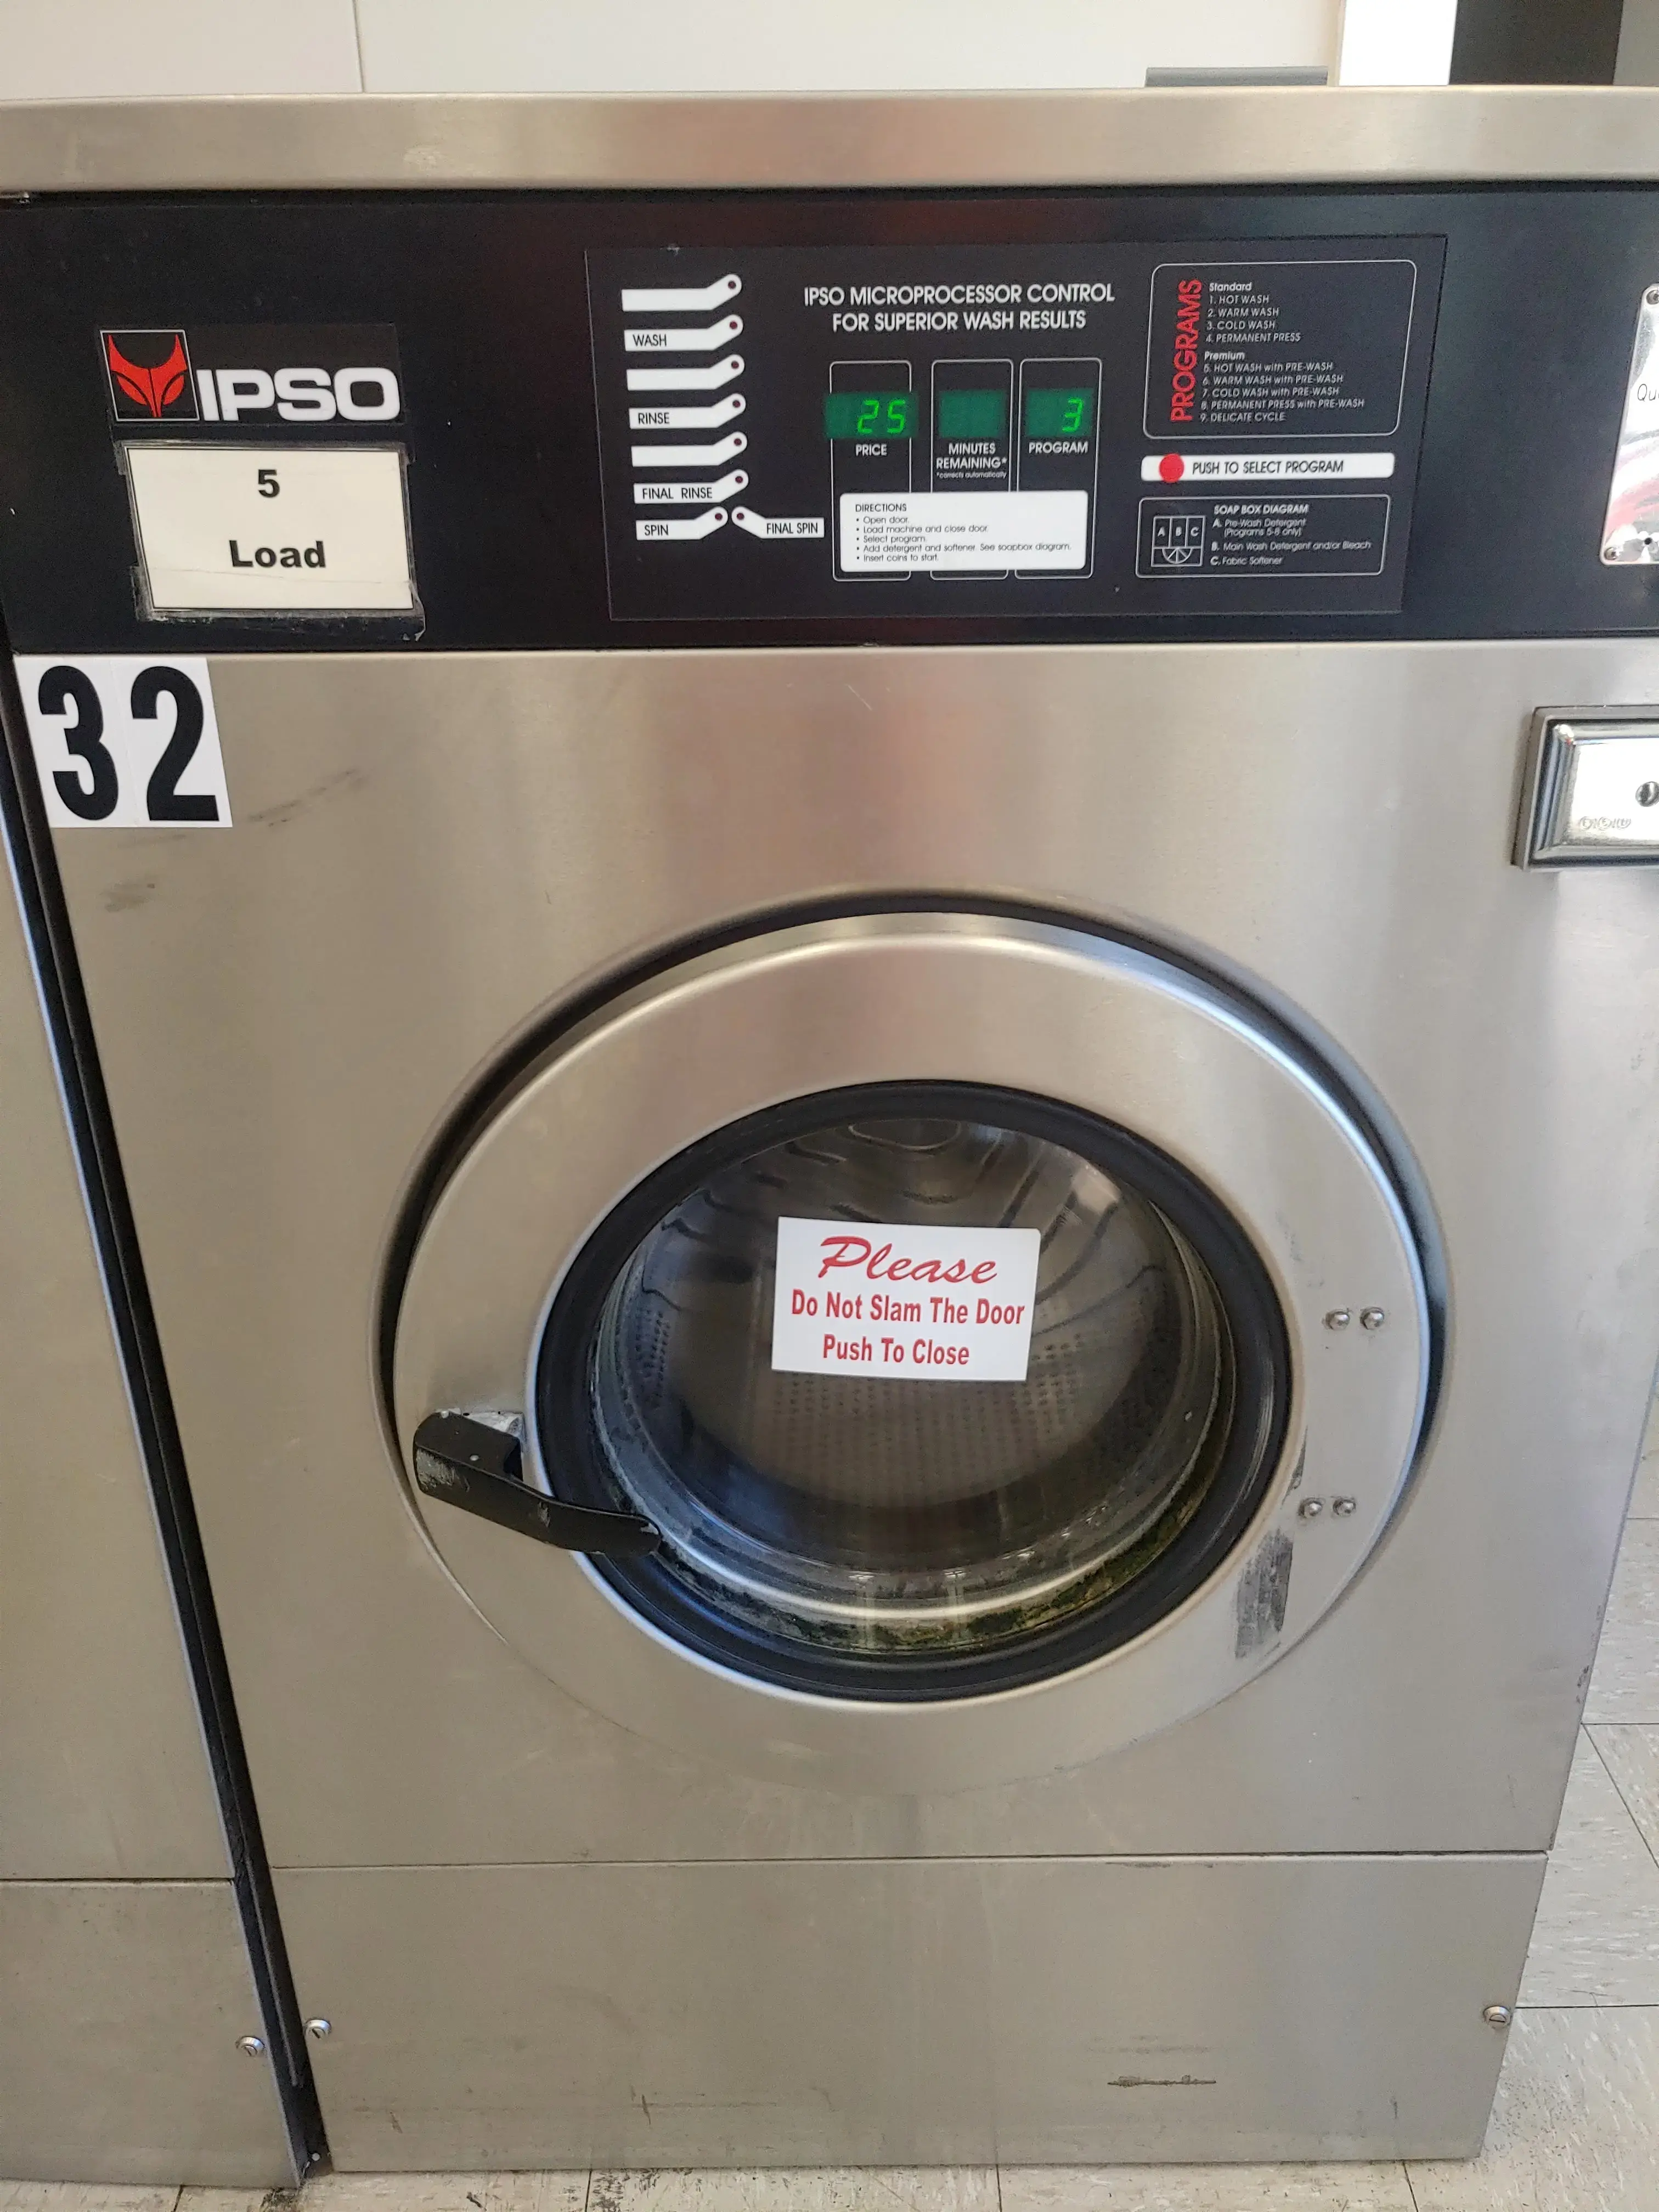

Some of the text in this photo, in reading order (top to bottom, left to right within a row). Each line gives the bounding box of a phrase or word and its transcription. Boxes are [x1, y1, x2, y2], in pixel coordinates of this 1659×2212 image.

[1209, 282, 1252, 291] Standard
[804, 284, 1115, 306] IPSO MICROPROCESSOR CONTROL
[1219, 295, 1240, 304] HOT
[1242, 295, 1269, 303] WASH
[1218, 308, 1249, 317] WARM
[1251, 307, 1279, 317] WASH
[833, 310, 1086, 331] FOR SUPERIOR WASH RESULTS
[1217, 320, 1245, 330] COLD
[1248, 320, 1276, 329] WASH
[633, 334, 667, 347] WASH
[1216, 333, 1271, 342] PERMANENT
[1273, 332, 1301, 342] PRESS
[1171, 279, 1202, 421] PROGRAMS
[1204, 351, 1245, 360] Premium
[1214, 363, 1233, 373] HOT
[1235, 363, 1261, 372] WASH
[1265, 363, 1283, 372] with
[1285, 362, 1333, 371] PRE-WASH
[1214, 376, 1243, 385] WARM
[1245, 376, 1271, 385] WASH
[1274, 375, 1293, 384] with
[1296, 374, 1343, 383] PRE-WASH
[196, 367, 400, 421] IPSO
[1212, 388, 1240, 398] COLD
[1242, 388, 1268, 397] WASH
[1271, 388, 1289, 397] with
[1293, 387, 1339, 396] PRE-WASH
[1211, 400, 1266, 410] PERMANENT
[1268, 399, 1295, 409] PRESS
[1297, 399, 1317, 408] with
[1318, 399, 1364, 408] PRE-WASH
[638, 413, 669, 425] RINSE
[857, 399, 906, 434] 25
[1062, 397, 1083, 432] 3
[1211, 412, 1252, 422] DELICATE
[1255, 411, 1287, 422] CYCLE
[856, 444, 887, 456] PRICE
[949, 442, 996, 454] MINUTES
[1029, 442, 1088, 454] PROGRAM
[1193, 460, 1344, 475] PUSH TO SELECT PROGRAM
[258, 469, 280, 498] 5
[642, 487, 712, 499] FINAL RINSE
[855, 504, 907, 512] DIRECTIONS
[1214, 504, 1309, 515] SOAP BOX DIAGRAM
[864, 516, 886, 525] Open
[1224, 518, 1262, 527] Pre-Wash
[1264, 518, 1307, 528] Detergent
[644, 524, 668, 536] SPIN
[766, 523, 817, 534] FINAL SPIN
[1158, 527, 1165, 537] A
[1176, 527, 1182, 537] B
[1190, 527, 1200, 537] C
[1224, 528, 1265, 538] (Programs
[1282, 527, 1302, 537] only)
[883, 544, 922, 554] detergent
[980, 543, 995, 551] See
[998, 543, 1032, 552] soapbox
[1223, 543, 1244, 551] Main
[1246, 542, 1267, 551] Wash
[1270, 541, 1311, 552] Detergent
[1313, 541, 1342, 550] and/or
[1343, 540, 1372, 550] Bleach
[229, 540, 327, 568] Load
[1222, 556, 1247, 565] Fabric
[1249, 556, 1283, 565] Softener
[38, 665, 219, 821] 32
[818, 1235, 997, 1284] Please
[792, 1288, 1025, 1325] Do Not Slam The Door
[823, 1334, 969, 1365] Push To Close
